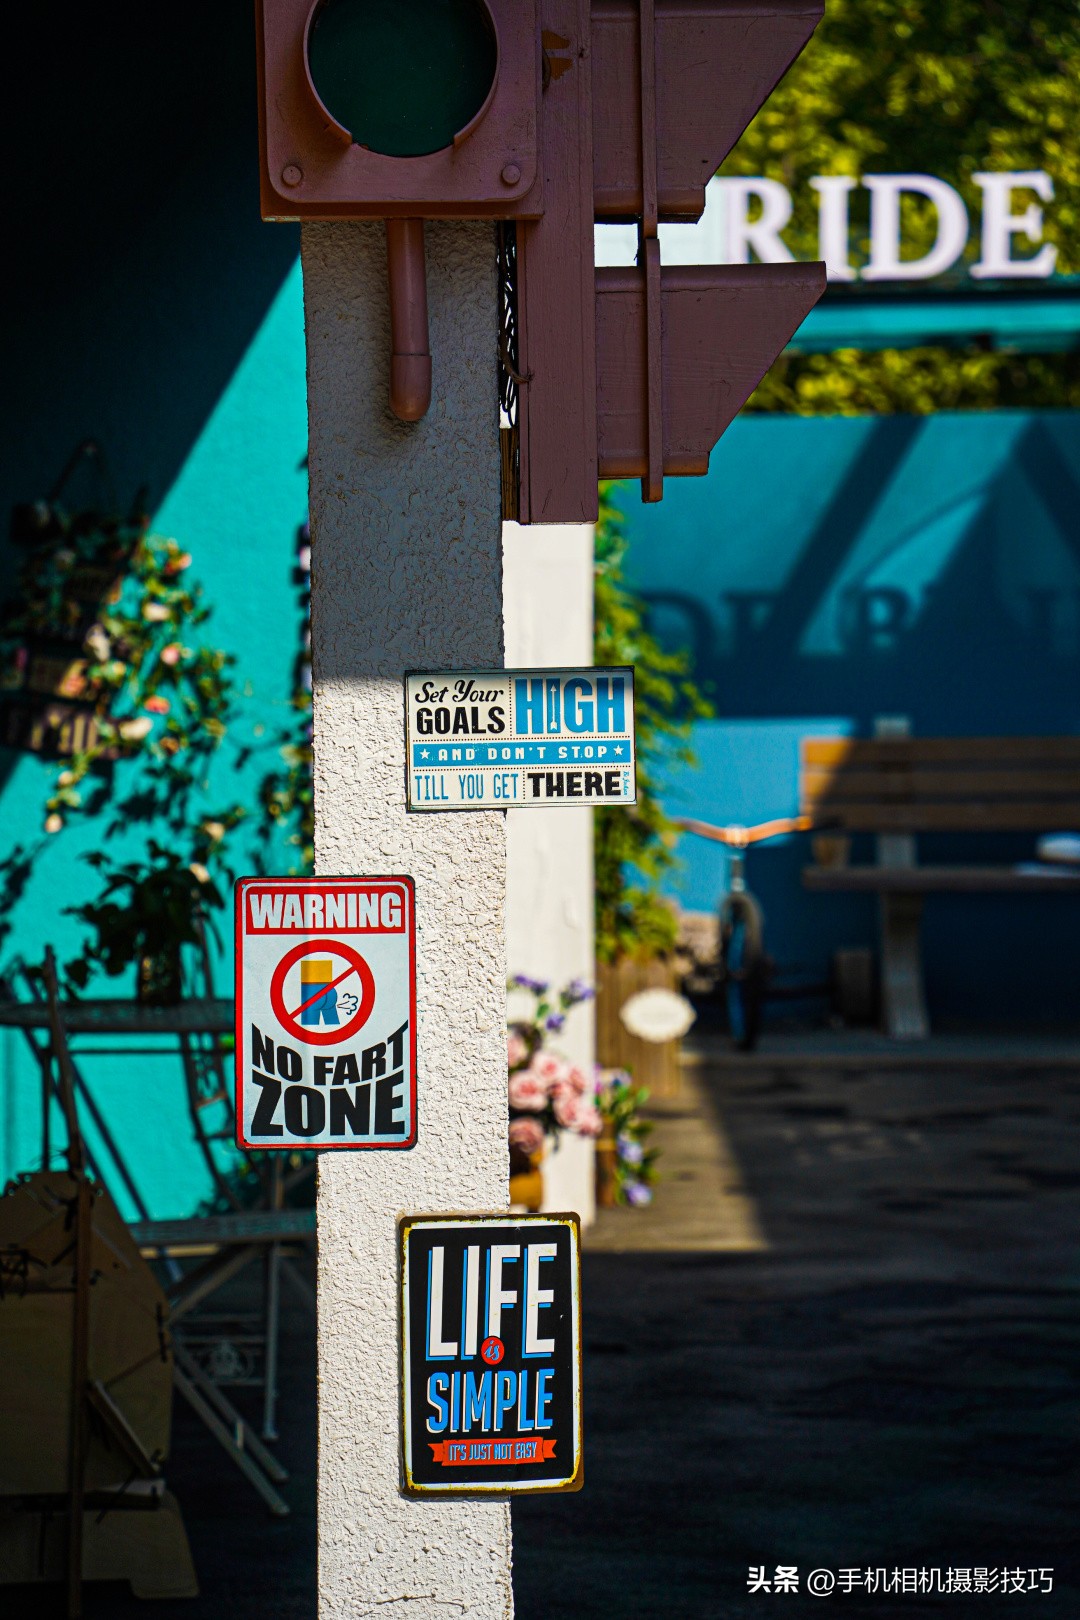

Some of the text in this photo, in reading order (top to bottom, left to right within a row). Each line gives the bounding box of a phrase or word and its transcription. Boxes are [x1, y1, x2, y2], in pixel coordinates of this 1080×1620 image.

[714, 170, 1058, 282] RIDE
[415, 679, 504, 703] Set Your
[515, 677, 626, 734] HIGH
[416, 706, 505, 734] GOALS
[438, 746, 608, 761] AND DON'T STOP
[415, 775, 449, 800] TILL
[459, 774, 484, 799] YOU
[493, 773, 519, 799] GET
[528, 771, 621, 797] THERE
[250, 892, 402, 929] WARNING
[251, 1019, 408, 1086] NO FART
[250, 1069, 405, 1137] ZONE
[426, 1243, 558, 1361] LIFE
[484, 1340, 500, 1361] is
[426, 1368, 555, 1433] SIMPLE
[448, 1442, 538, 1461] IT'S JUST NOT EASY
